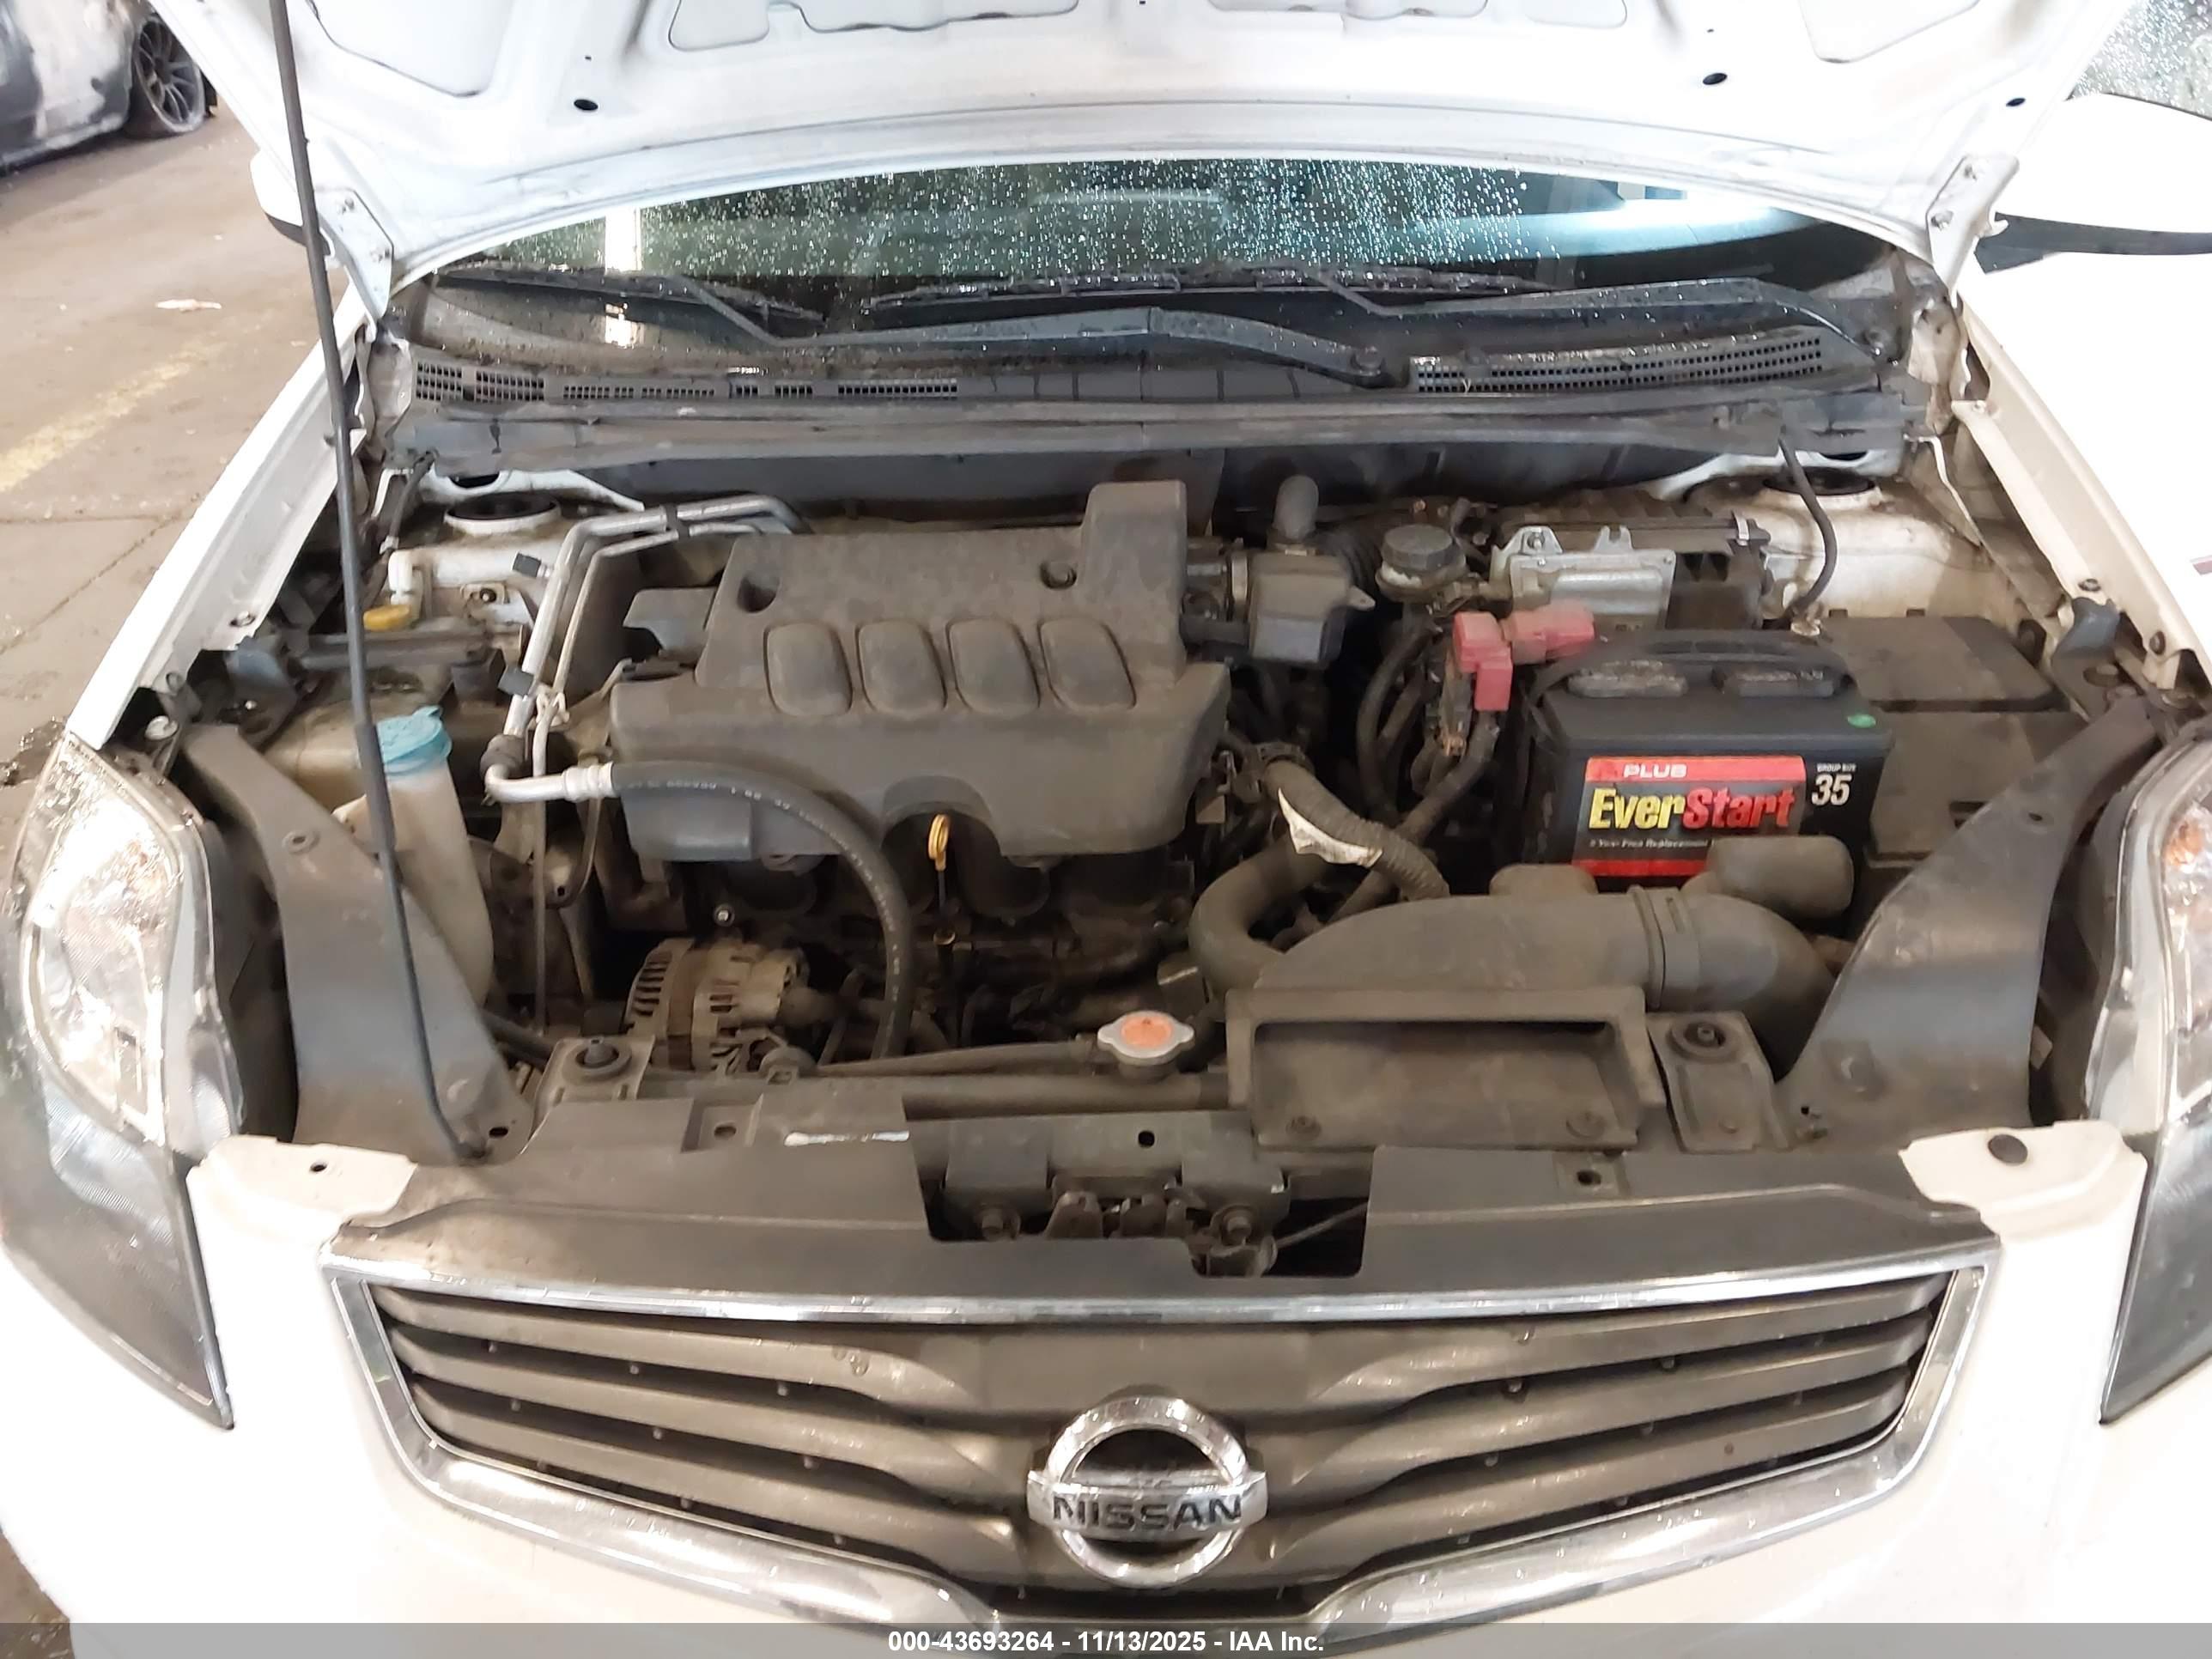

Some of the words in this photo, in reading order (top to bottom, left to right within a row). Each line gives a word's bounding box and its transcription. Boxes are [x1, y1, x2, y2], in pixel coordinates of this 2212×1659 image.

[1623, 763, 1687, 778] PLUS
[1811, 774, 1852, 805] 35
[1589, 787, 1795, 830] EverStart
[1053, 1496, 1242, 1530] NISSAN
